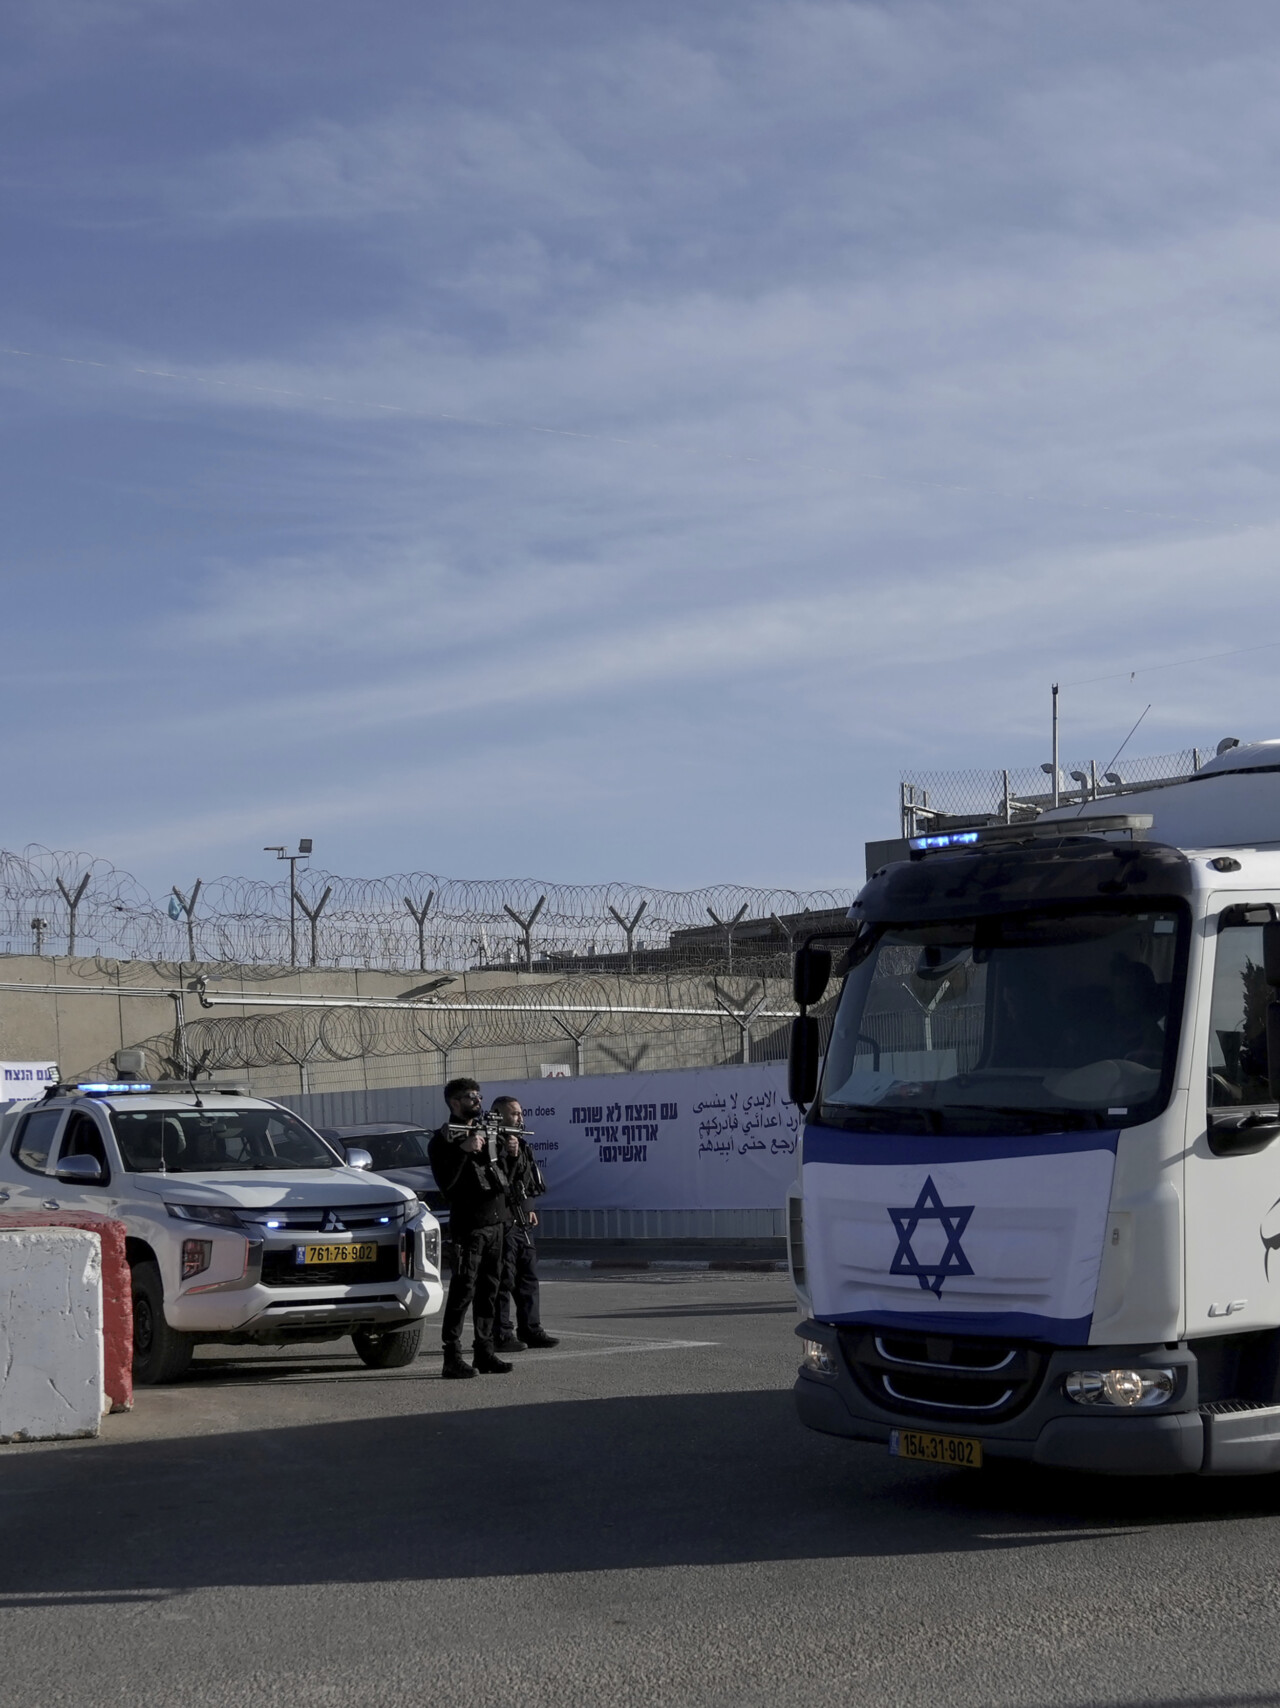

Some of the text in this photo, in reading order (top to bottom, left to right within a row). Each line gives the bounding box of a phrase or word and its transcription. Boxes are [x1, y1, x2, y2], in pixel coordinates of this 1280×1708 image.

[5, 1069, 33, 1081] הנצח
[692, 1093, 726, 1114] ينسى
[730, 1092, 738, 1110] لا
[535, 1105, 556, 1117] does
[569, 1102, 678, 1124] עם הנצח לא שוכח.
[585, 1123, 659, 1145] ארדוף אויביי
[527, 1139, 559, 1151] nemies
[599, 1144, 647, 1163] ואשיגם!
[738, 1135, 767, 1155] حتى
[1207, 1299, 1249, 1318] LF
